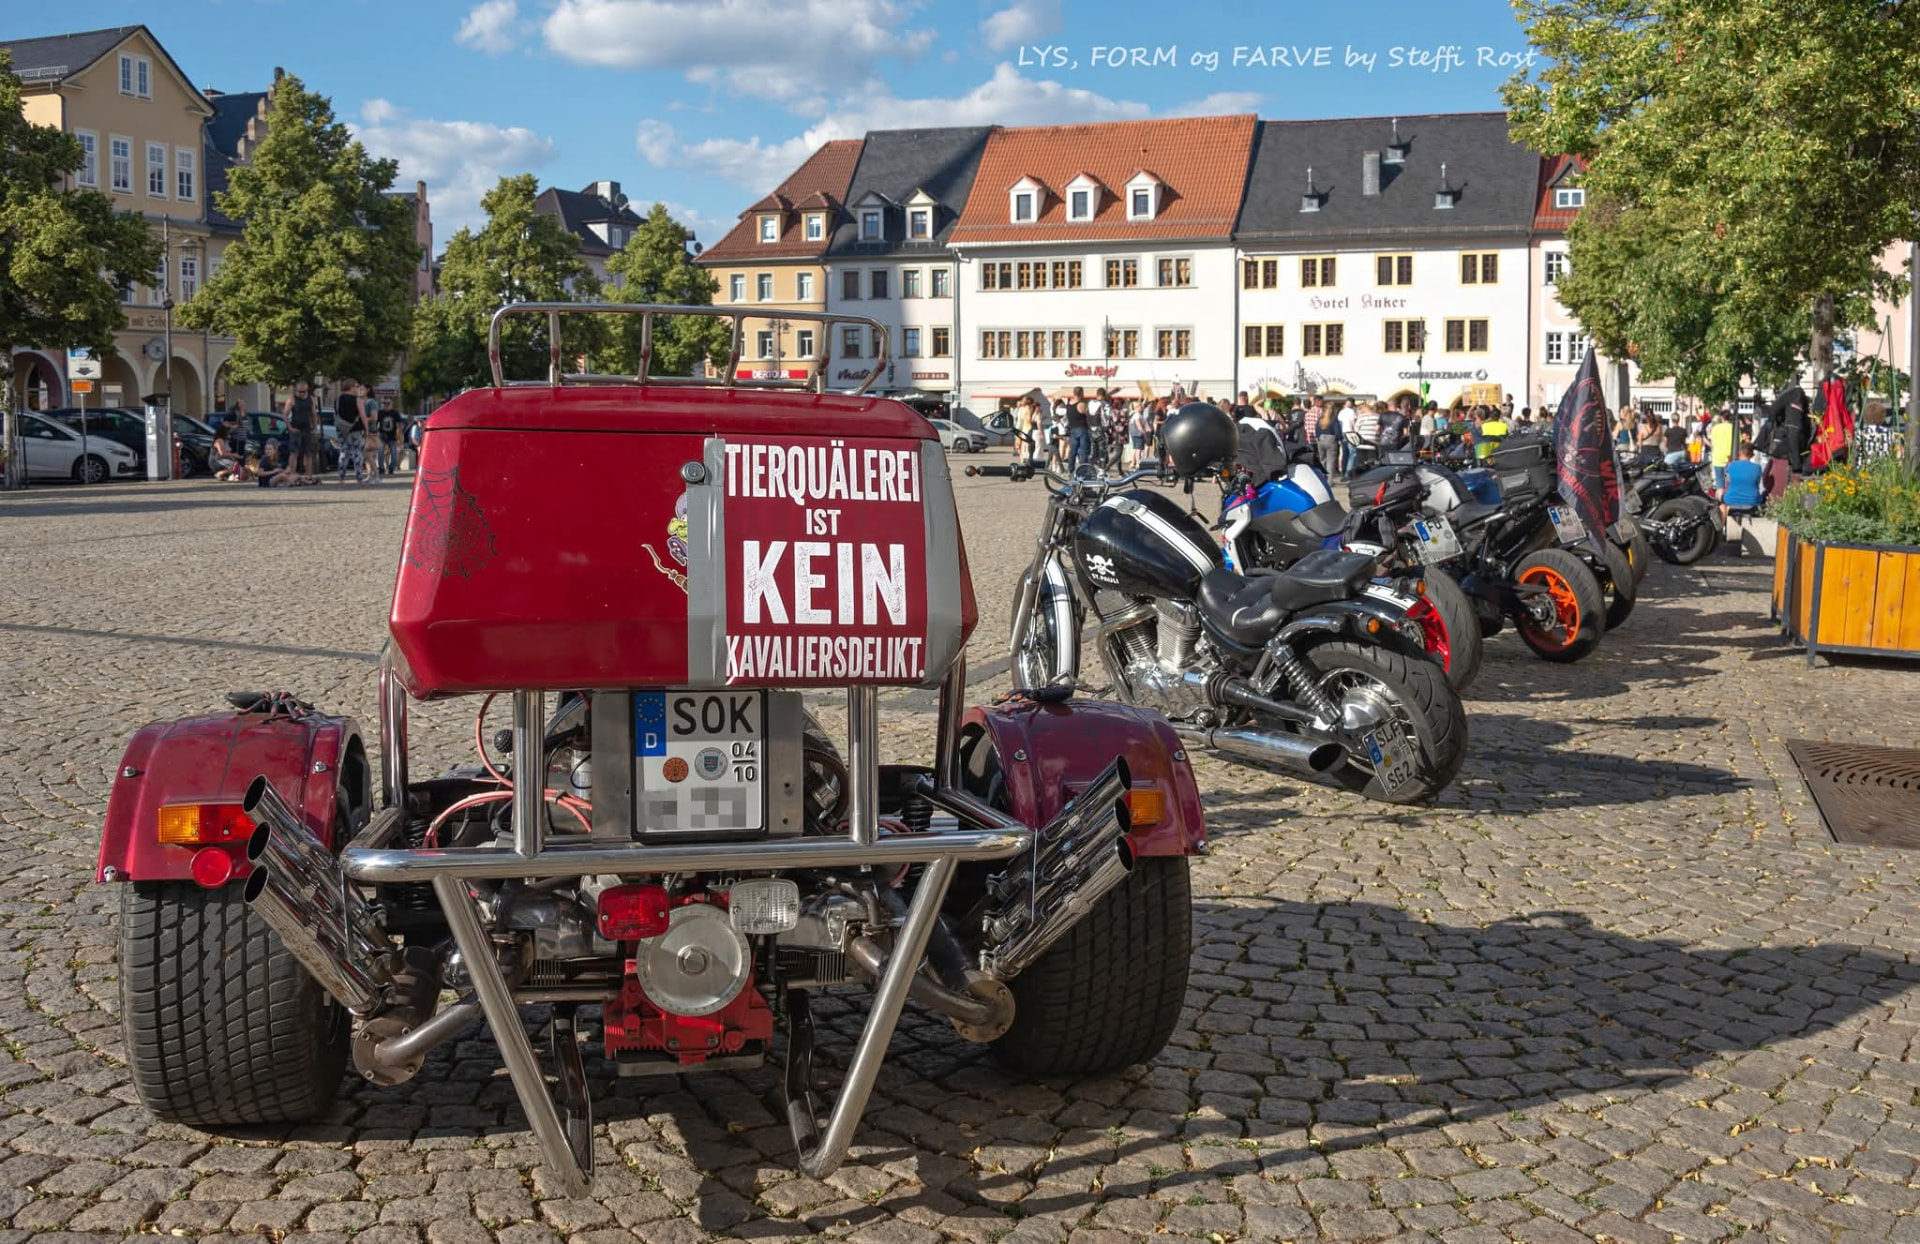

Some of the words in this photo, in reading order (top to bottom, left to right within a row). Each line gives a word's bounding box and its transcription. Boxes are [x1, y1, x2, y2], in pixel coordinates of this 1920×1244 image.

[1309, 296, 1349, 310] Hotel
[1361, 293, 1407, 309] Anker
[752, 369, 790, 380] DERTOUR
[1398, 371, 1473, 380] COMMERZBANK
[725, 440, 920, 506] TIERQUÄLEREI
[805, 508, 842, 536] IST
[742, 540, 907, 626] KEIN
[726, 635, 926, 680] KAVALIERSDELIKT.
[673, 696, 754, 735] SOK
[645, 732, 658, 749] D
[731, 741, 757, 759] 04
[733, 765, 756, 783] 10
